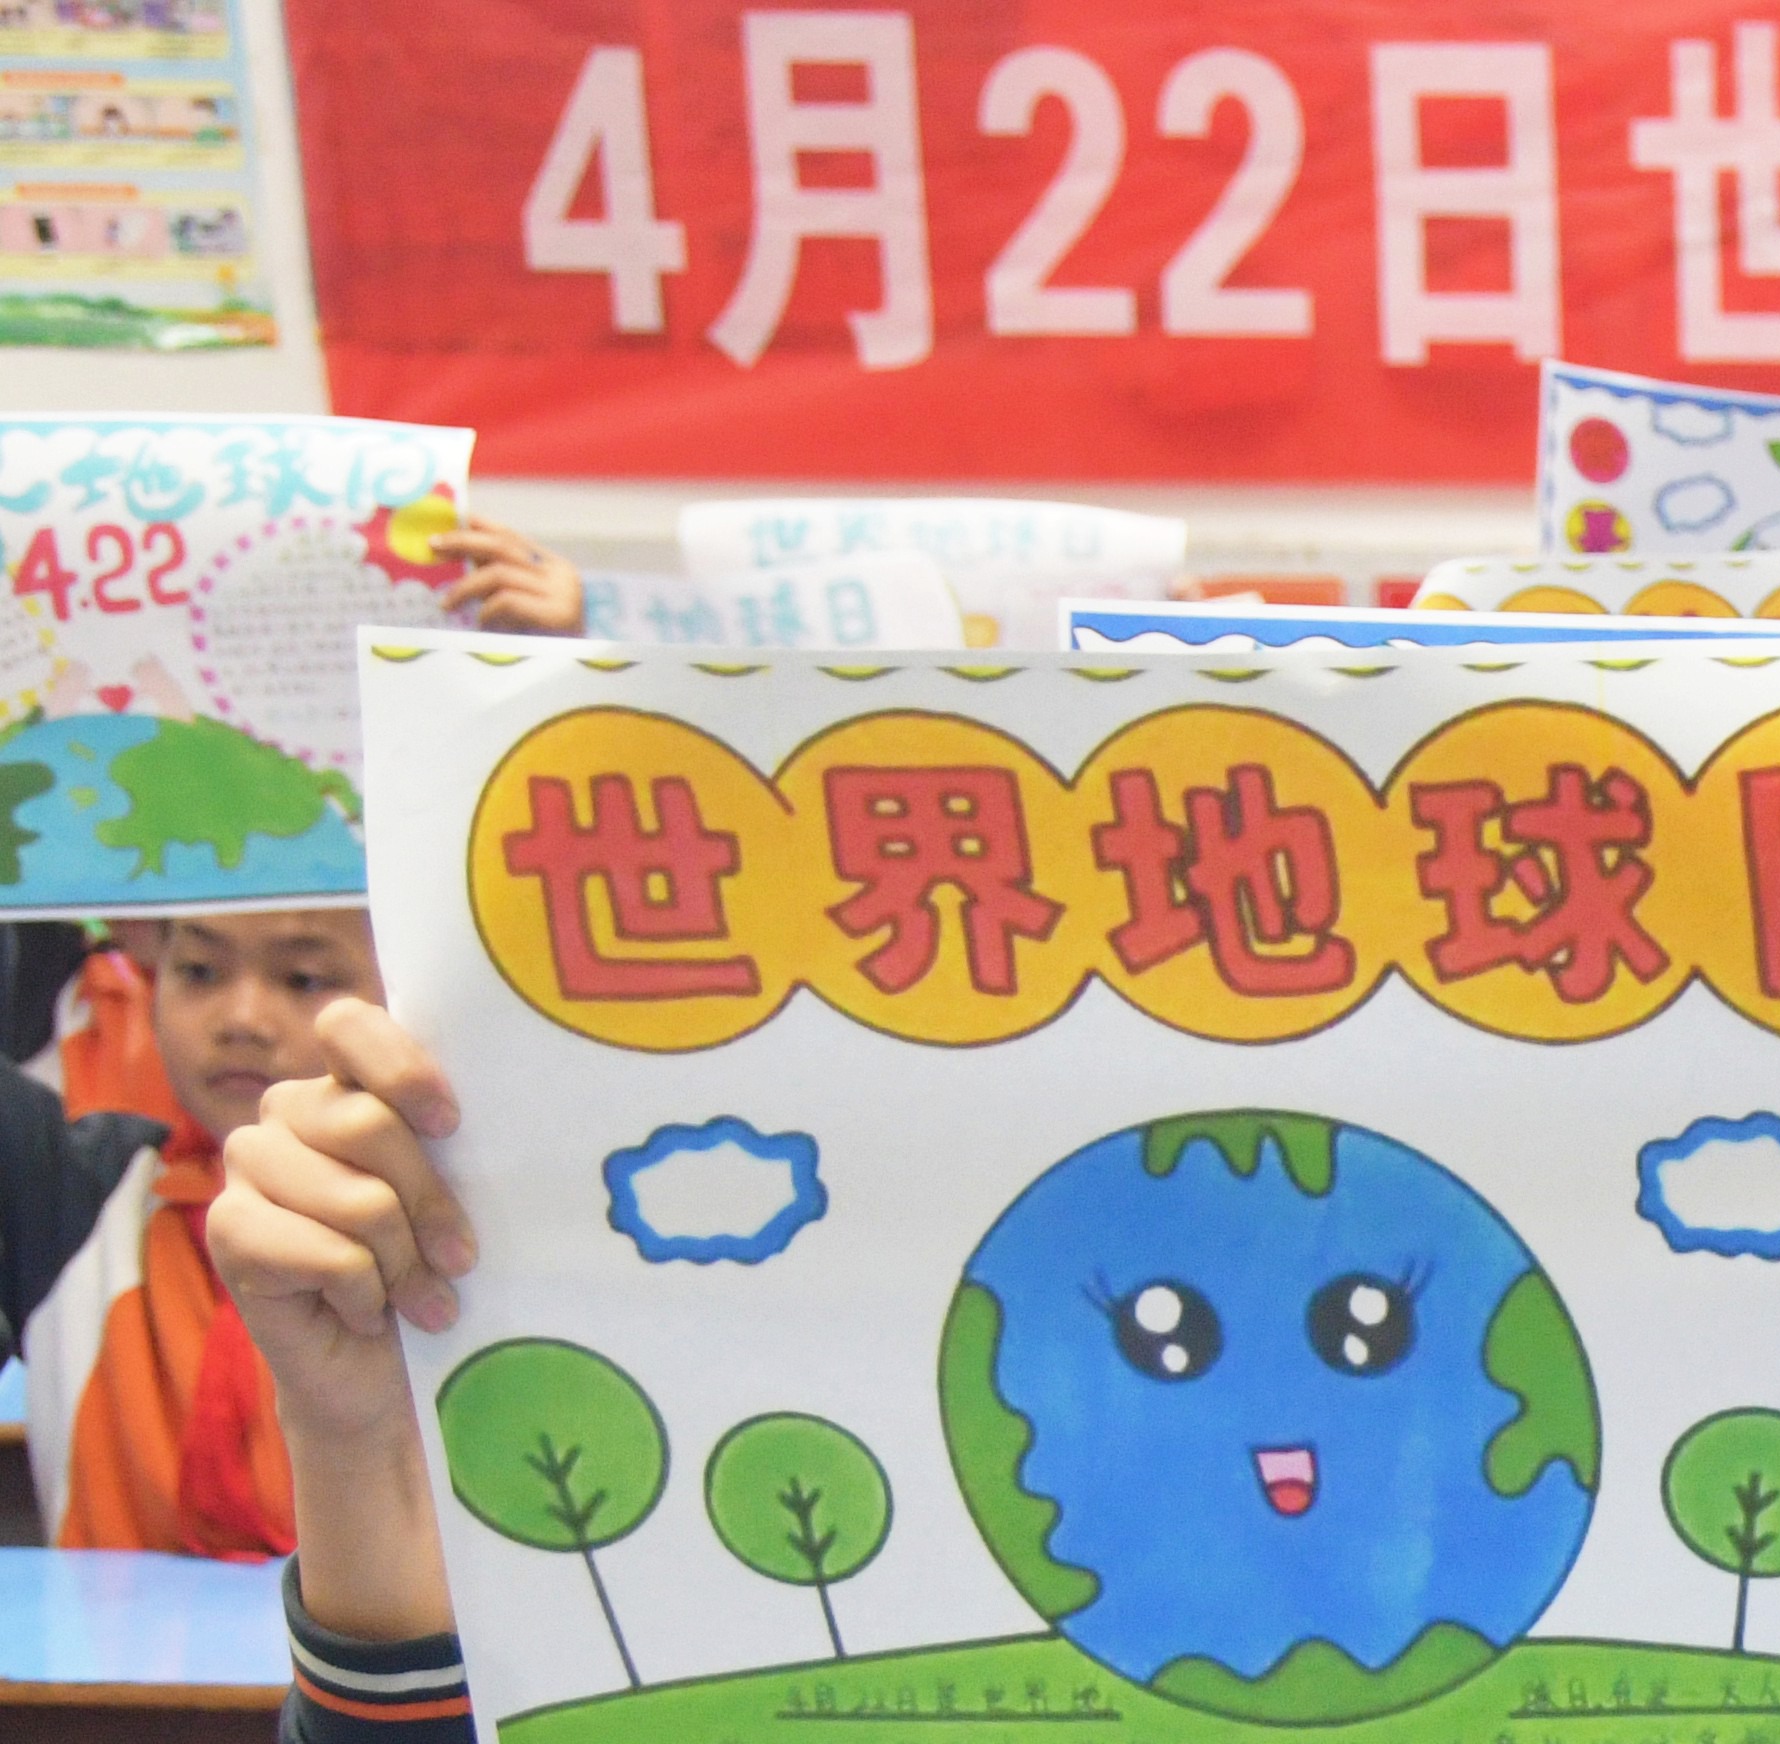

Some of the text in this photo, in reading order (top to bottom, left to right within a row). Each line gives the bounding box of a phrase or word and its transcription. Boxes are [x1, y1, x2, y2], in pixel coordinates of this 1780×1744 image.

[0, 440, 437, 522] 地球日
[13, 521, 193, 621] 4.22
